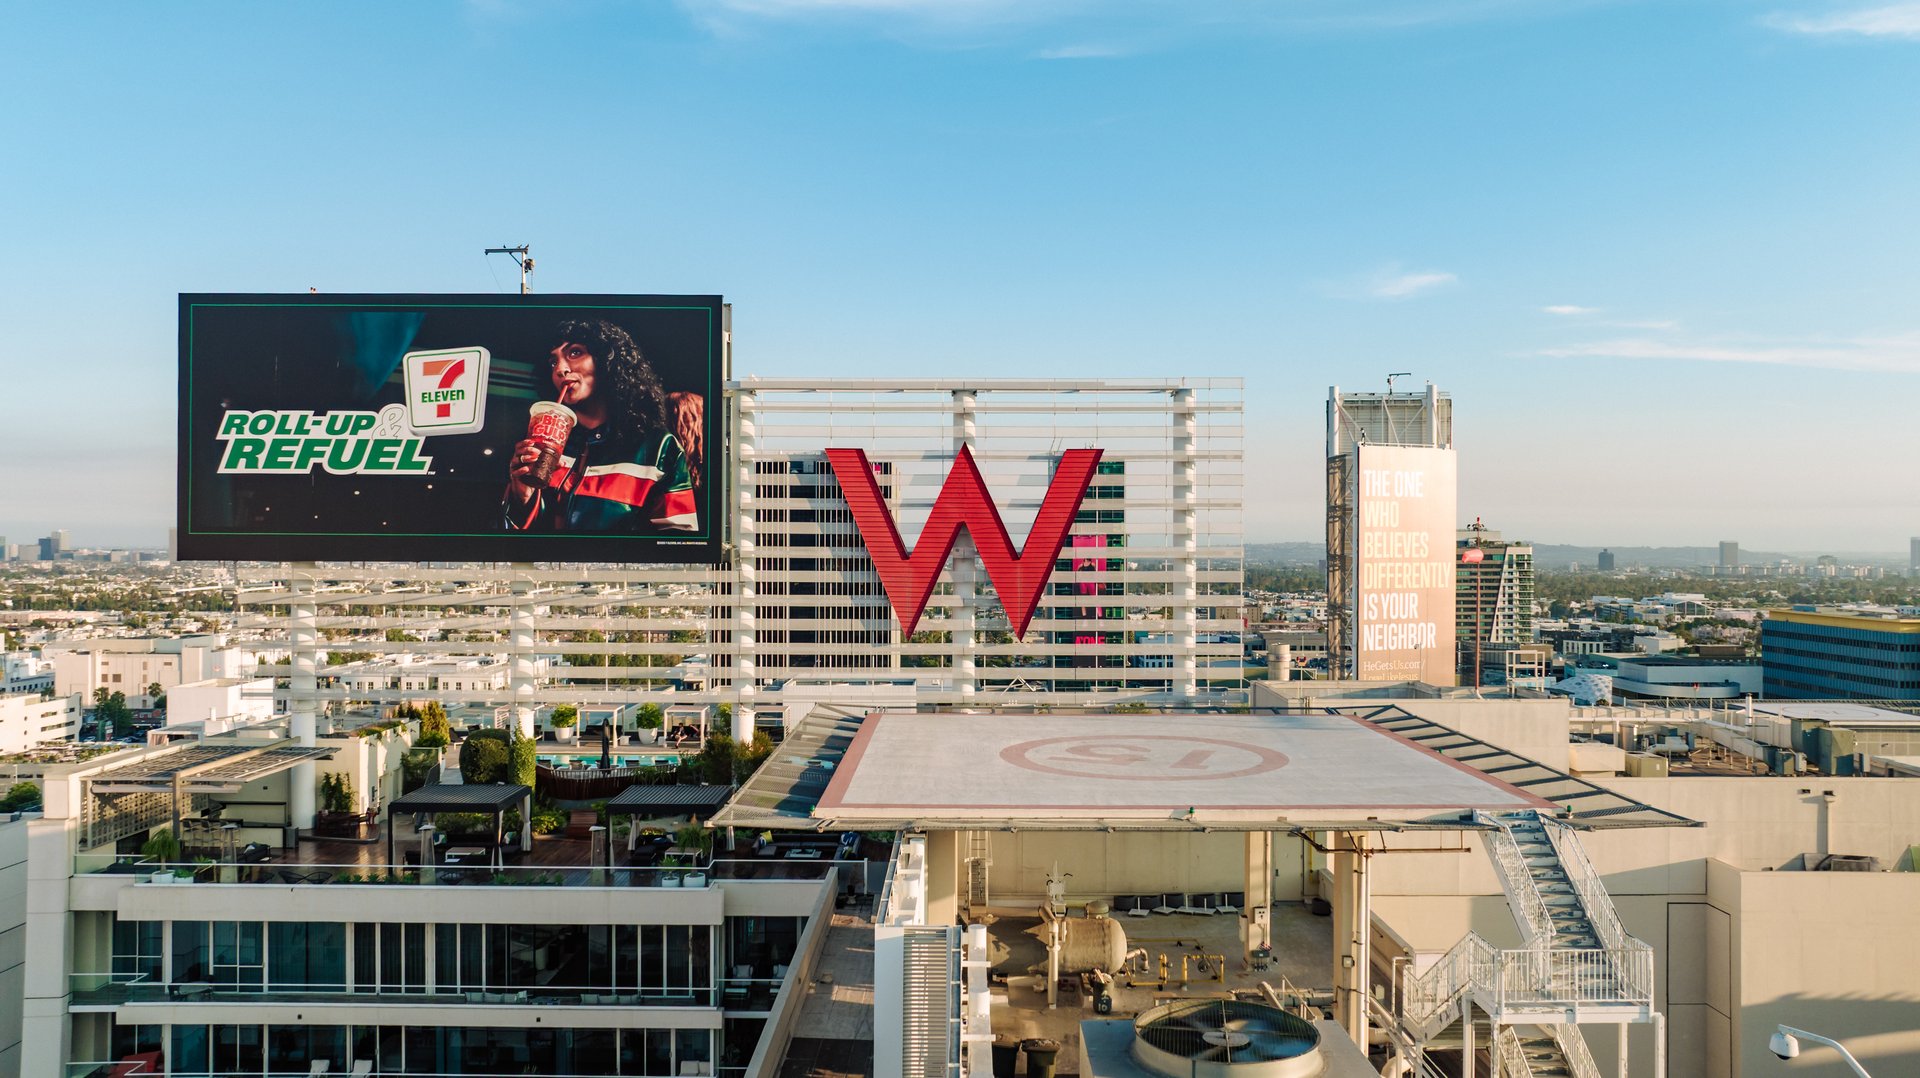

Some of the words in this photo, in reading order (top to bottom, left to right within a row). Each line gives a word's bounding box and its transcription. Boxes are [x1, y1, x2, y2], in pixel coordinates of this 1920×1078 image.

[221, 413, 377, 436] ROLL-UP
[371, 406, 405, 440] &
[223, 438, 429, 471] REFUEL
[1363, 469, 1391, 498] THE
[1394, 470, 1425, 498] ONE
[1363, 500, 1400, 529] WHO
[824, 441, 1105, 642] W
[1363, 530, 1430, 559] BELIEVES
[1363, 561, 1452, 590] DIFFERENTLY
[1363, 592, 1379, 621] IS
[1380, 591, 1419, 620] YOUR
[1363, 621, 1437, 652] NEIGHBOR
